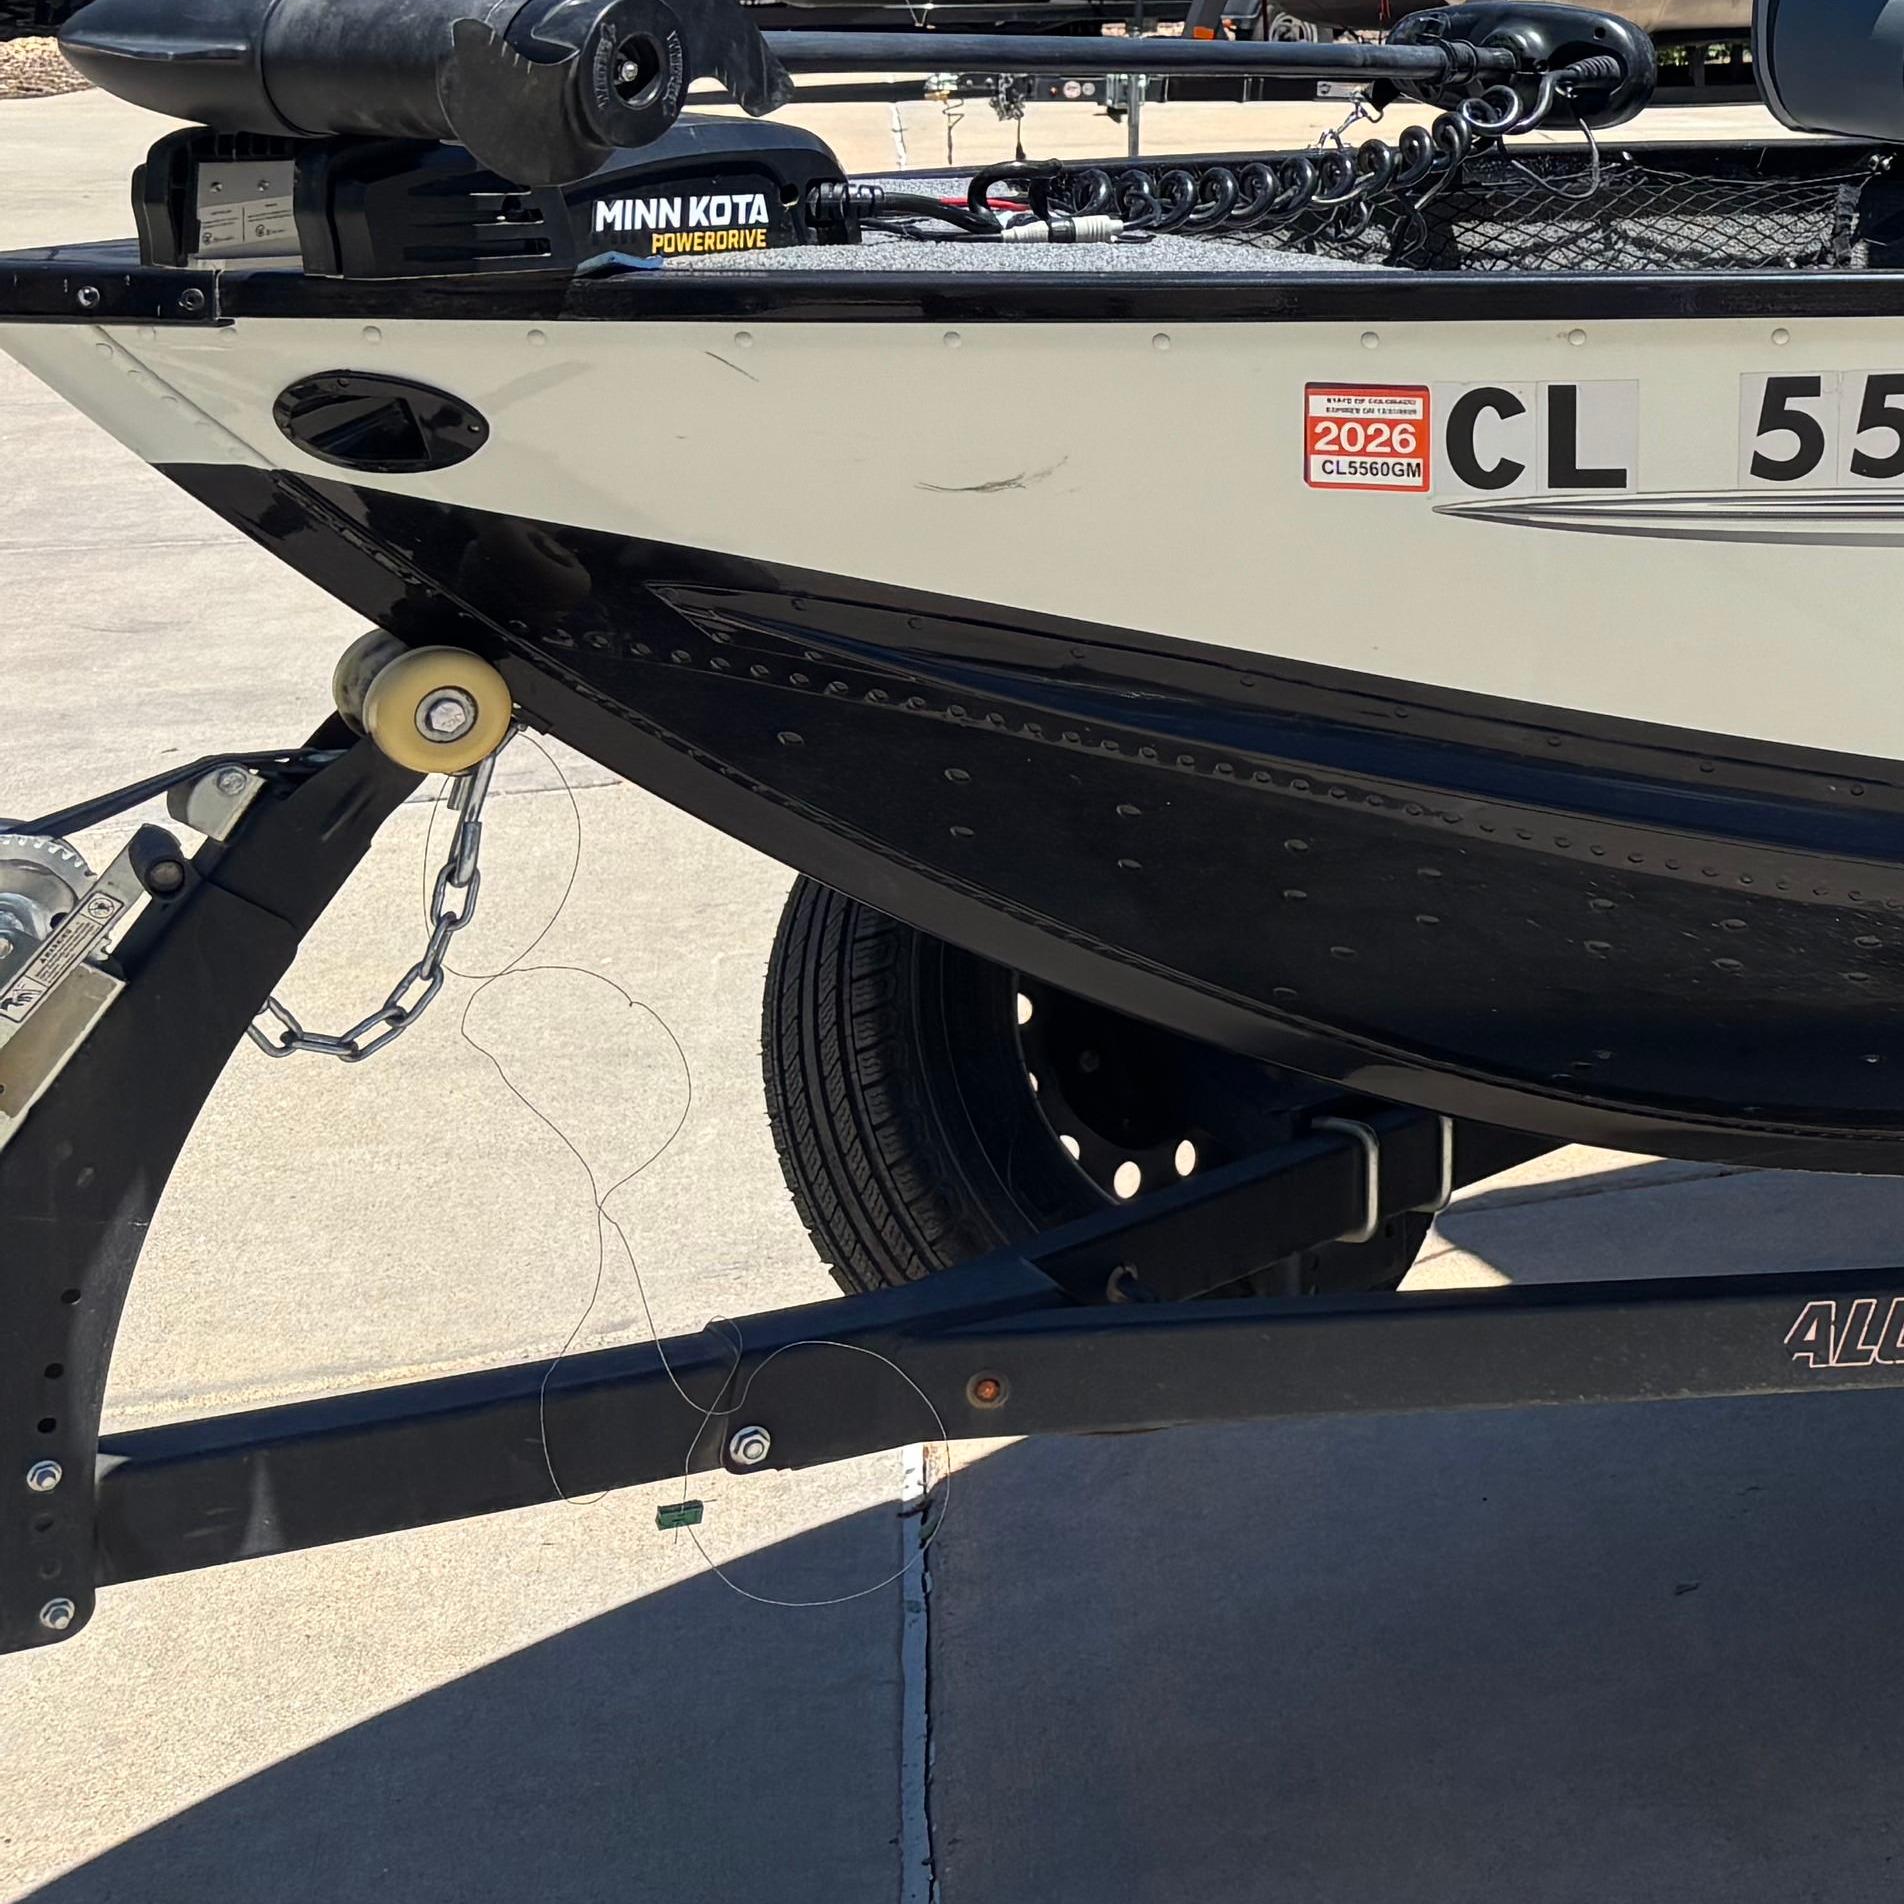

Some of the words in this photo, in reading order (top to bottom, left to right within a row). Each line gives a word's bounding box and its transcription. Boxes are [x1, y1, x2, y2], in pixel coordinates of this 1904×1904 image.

[595, 197, 682, 232] MINN
[688, 194, 769, 227] KOTA
[651, 228, 768, 254] POWERDRIVE
[1314, 420, 1417, 455] 2026
[1446, 384, 1628, 491] CL
[1321, 459, 1421, 478] CL5560GM
